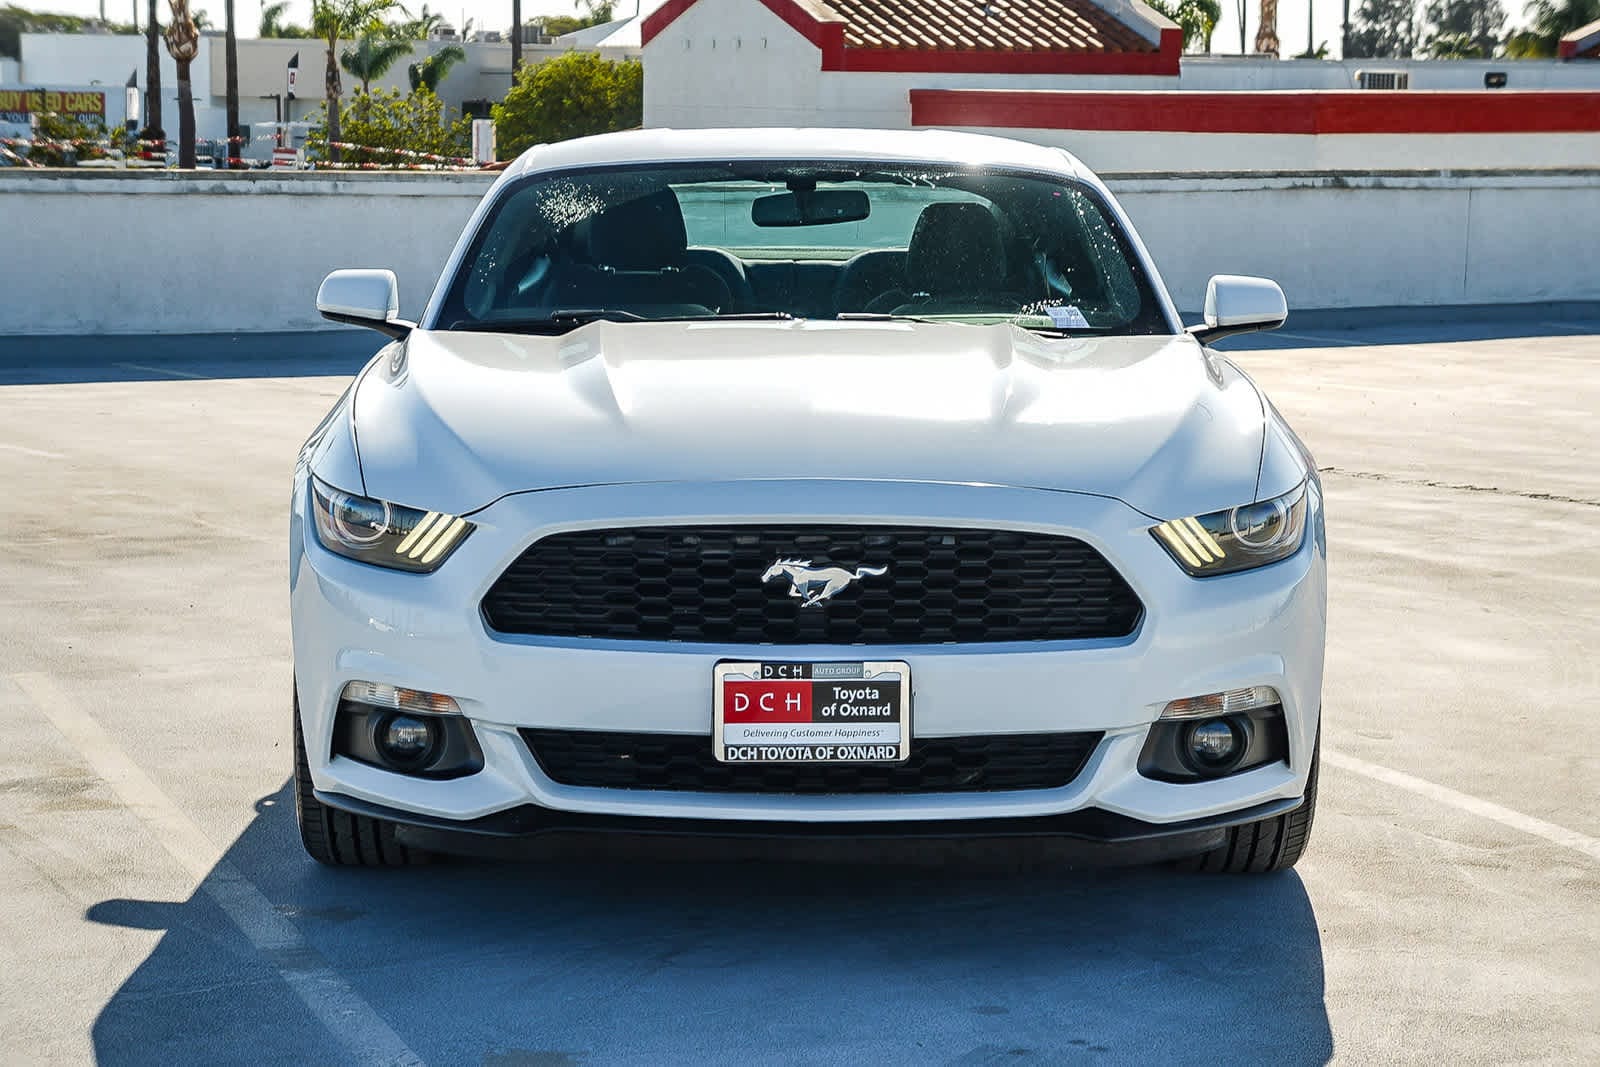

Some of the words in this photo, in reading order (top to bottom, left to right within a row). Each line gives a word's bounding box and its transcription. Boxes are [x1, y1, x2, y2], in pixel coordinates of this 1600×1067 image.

[26, 91, 62, 111] USED
[65, 92, 102, 111] CARS
[764, 665, 802, 677] DCH
[815, 666, 834, 674] AUTO
[835, 666, 861, 674] GROUP
[832, 686, 879, 703] Toyota
[734, 692, 801, 712] DCH
[821, 703, 837, 716] of
[839, 702, 891, 716] Oxnard
[743, 728, 788, 739] Delivering
[790, 728, 832, 738] Customer
[834, 728, 880, 739] Happiness
[728, 747, 757, 760] DCH
[758, 747, 813, 760] TOYOTA
[815, 746, 833, 760] OF
[837, 746, 896, 760] OXNARD
